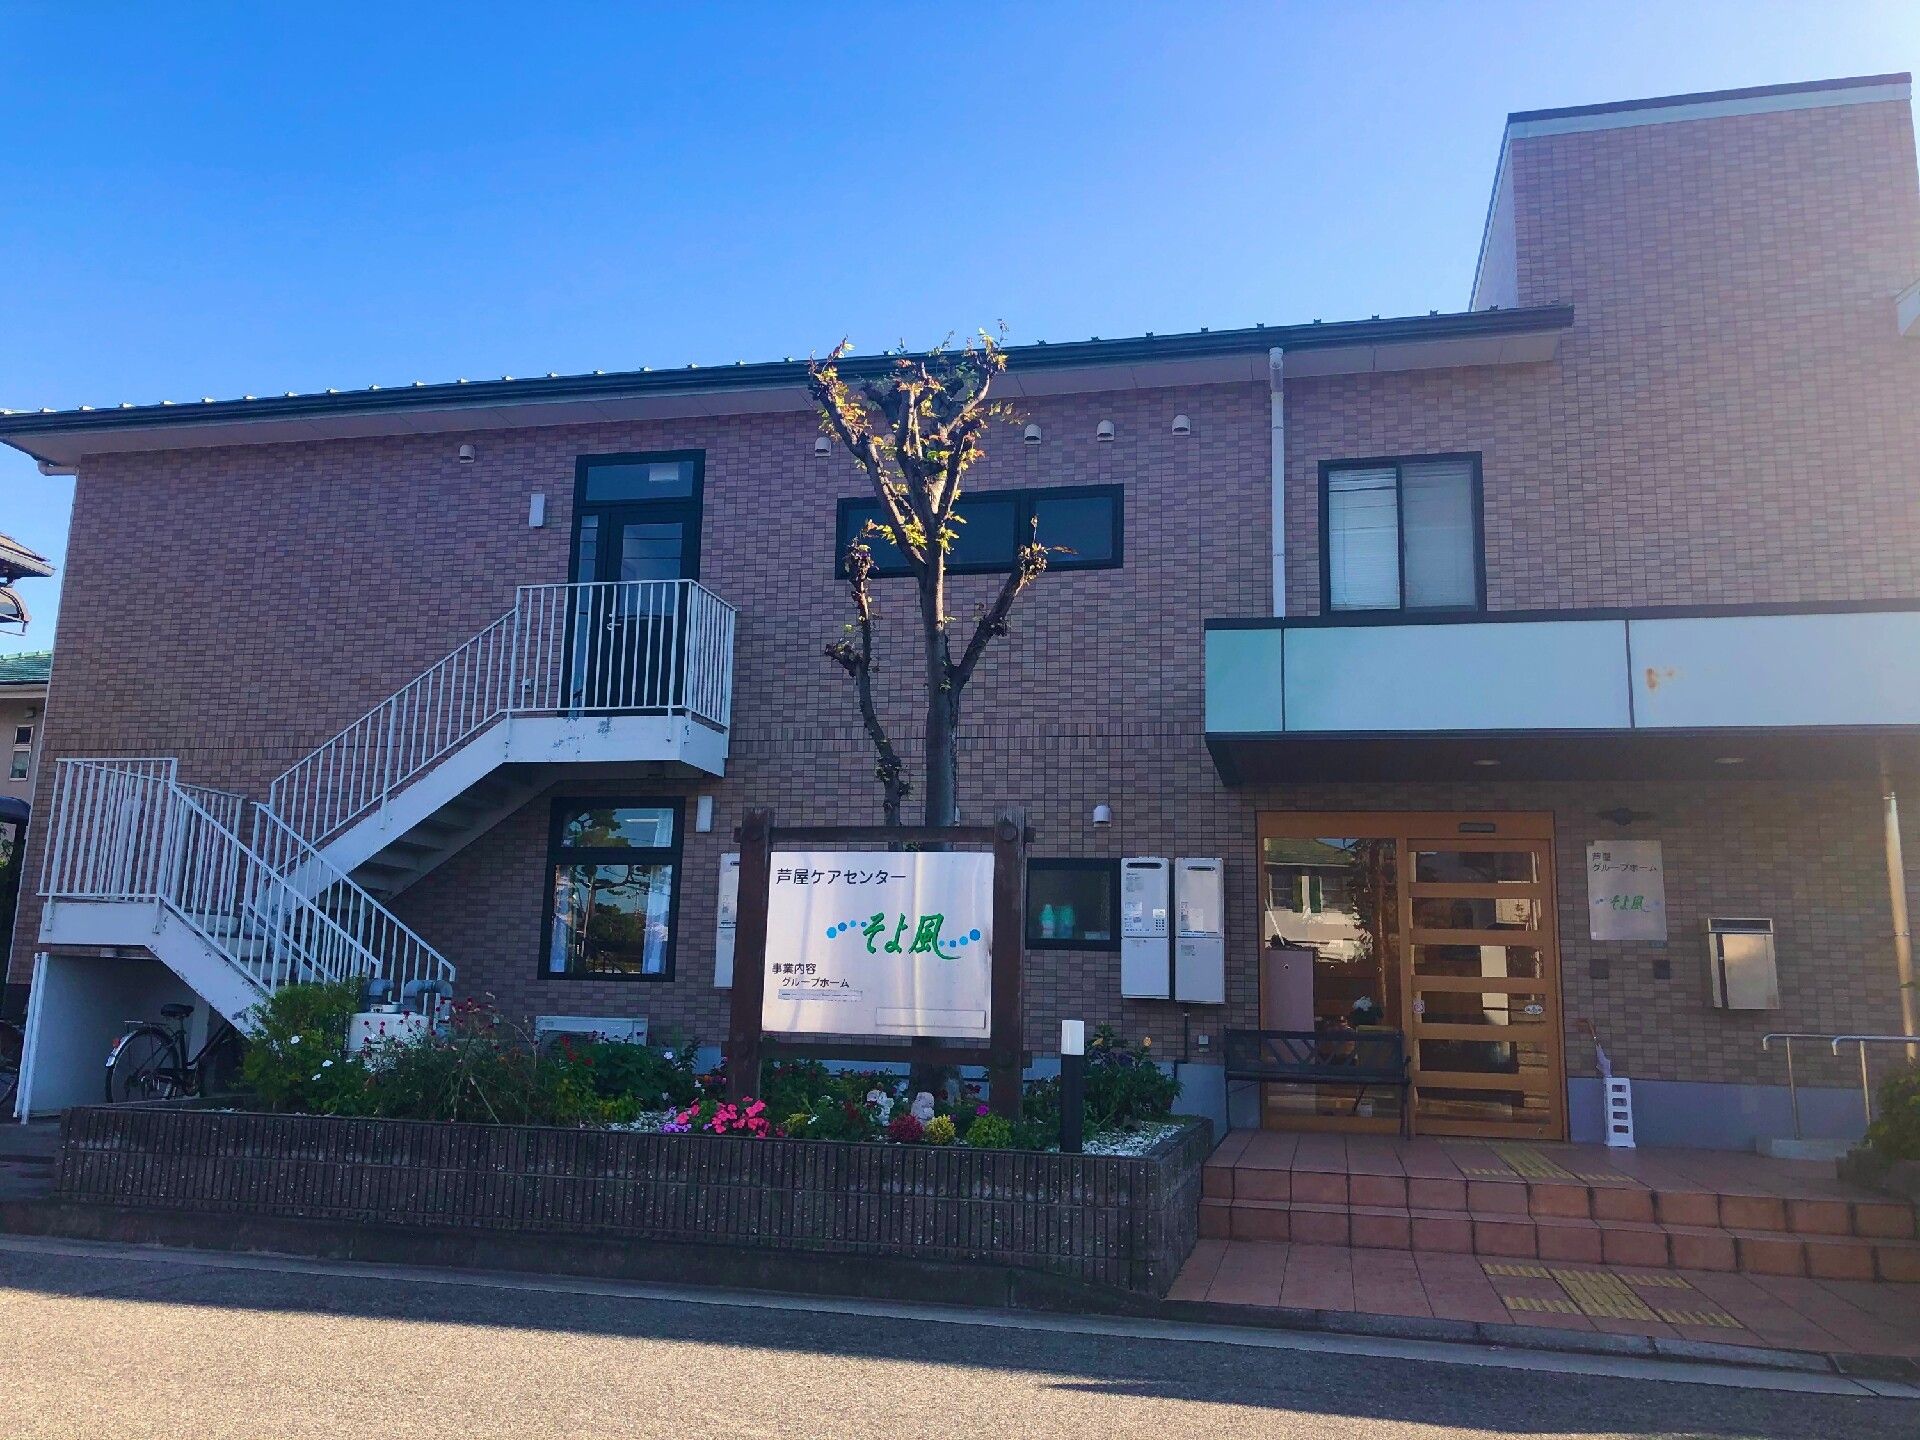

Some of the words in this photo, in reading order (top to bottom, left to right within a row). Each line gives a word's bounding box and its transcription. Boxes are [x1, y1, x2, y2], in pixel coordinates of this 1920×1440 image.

[776, 868, 907, 885] 芦屋ケアセンター
[862, 912, 961, 960] そよ風
[772, 962, 817, 975] 事業内容
[782, 976, 850, 988] グループホーム
